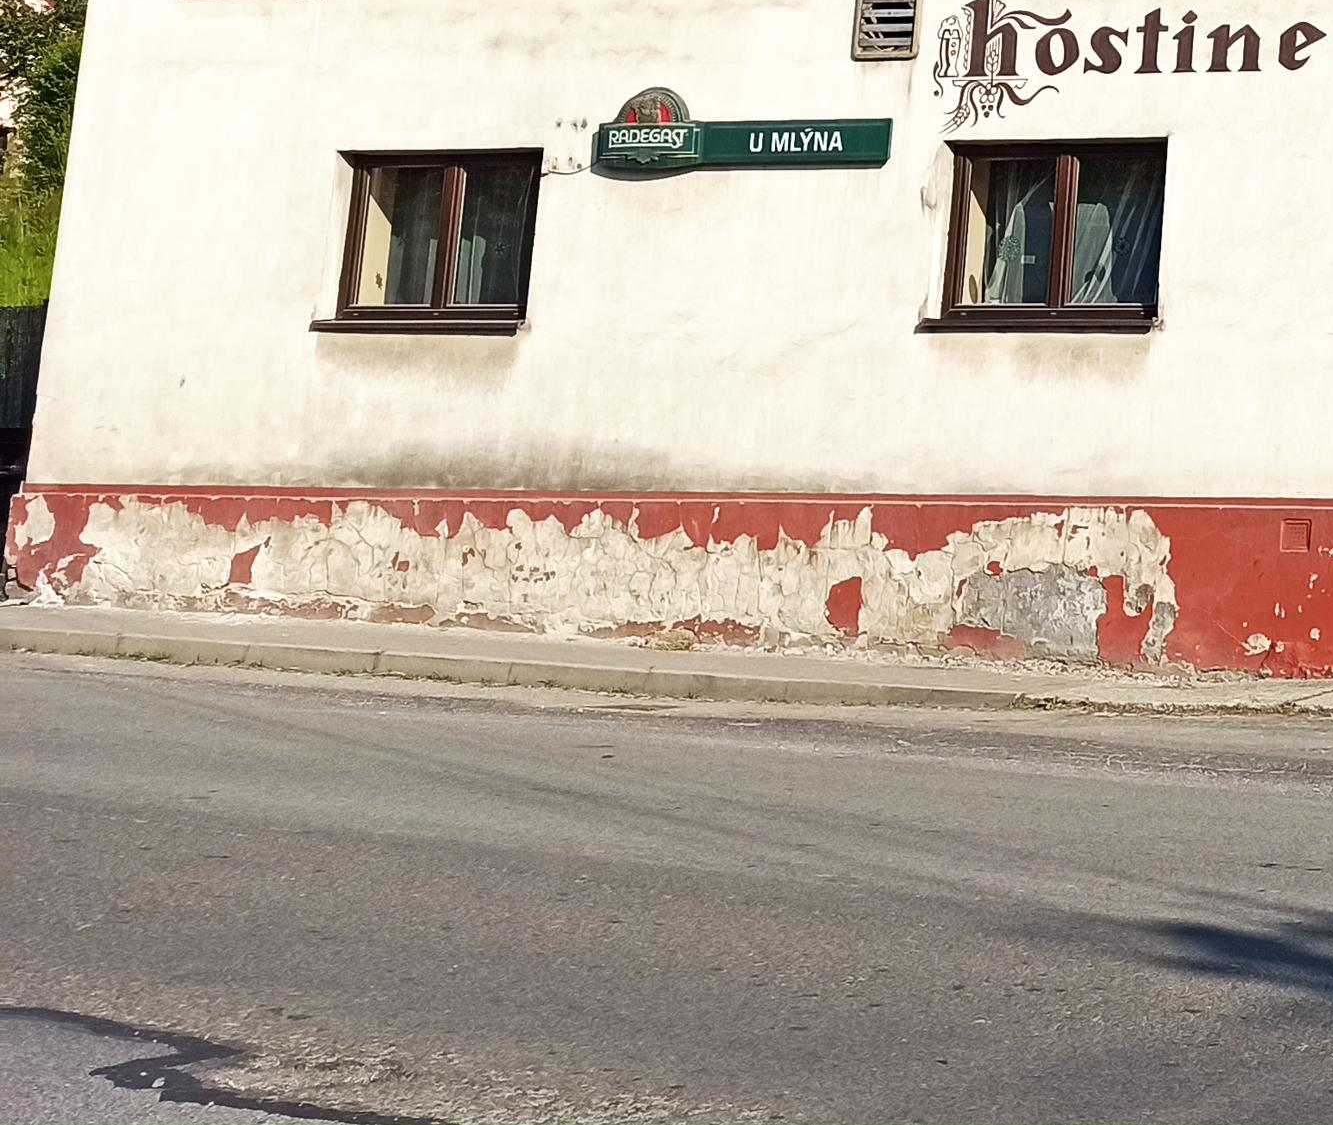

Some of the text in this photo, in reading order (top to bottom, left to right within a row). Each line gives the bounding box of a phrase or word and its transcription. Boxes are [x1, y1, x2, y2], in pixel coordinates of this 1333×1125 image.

[608, 128, 689, 149] RADEGAST
[749, 128, 844, 153] U MLÝNA
